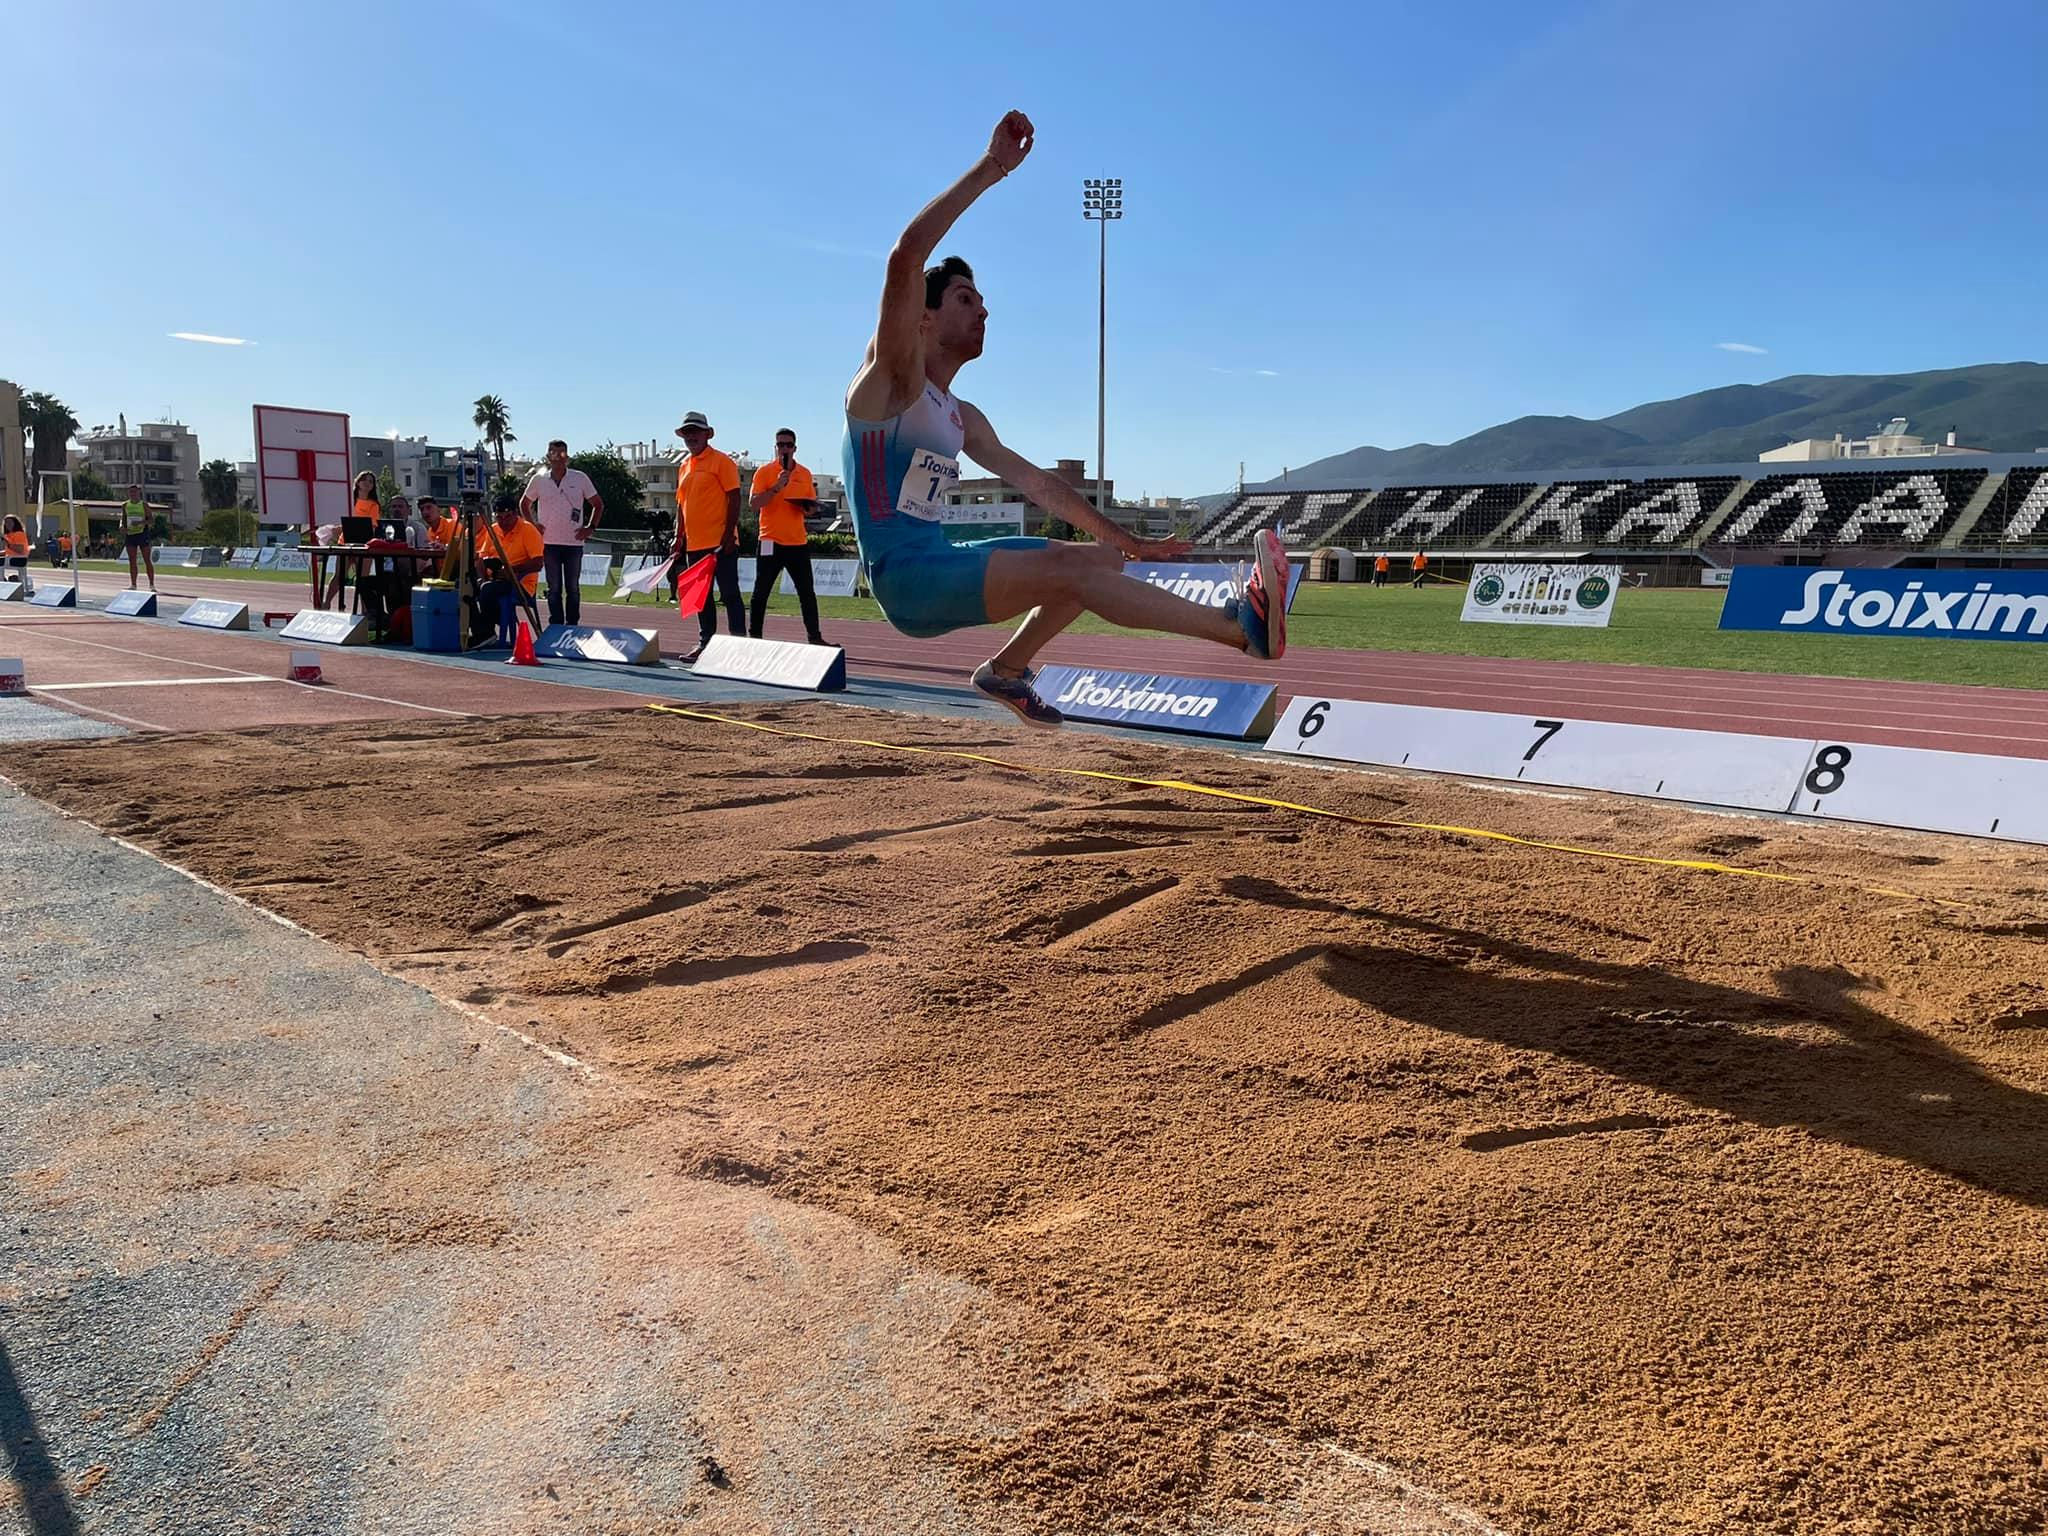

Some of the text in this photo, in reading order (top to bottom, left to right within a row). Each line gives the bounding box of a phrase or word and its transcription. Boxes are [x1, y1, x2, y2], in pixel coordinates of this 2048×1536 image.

[1055, 674, 1219, 718] Stoiximan
[1297, 700, 1331, 739] 6
[1523, 719, 1565, 761] 7
[1805, 744, 1852, 795] 8
